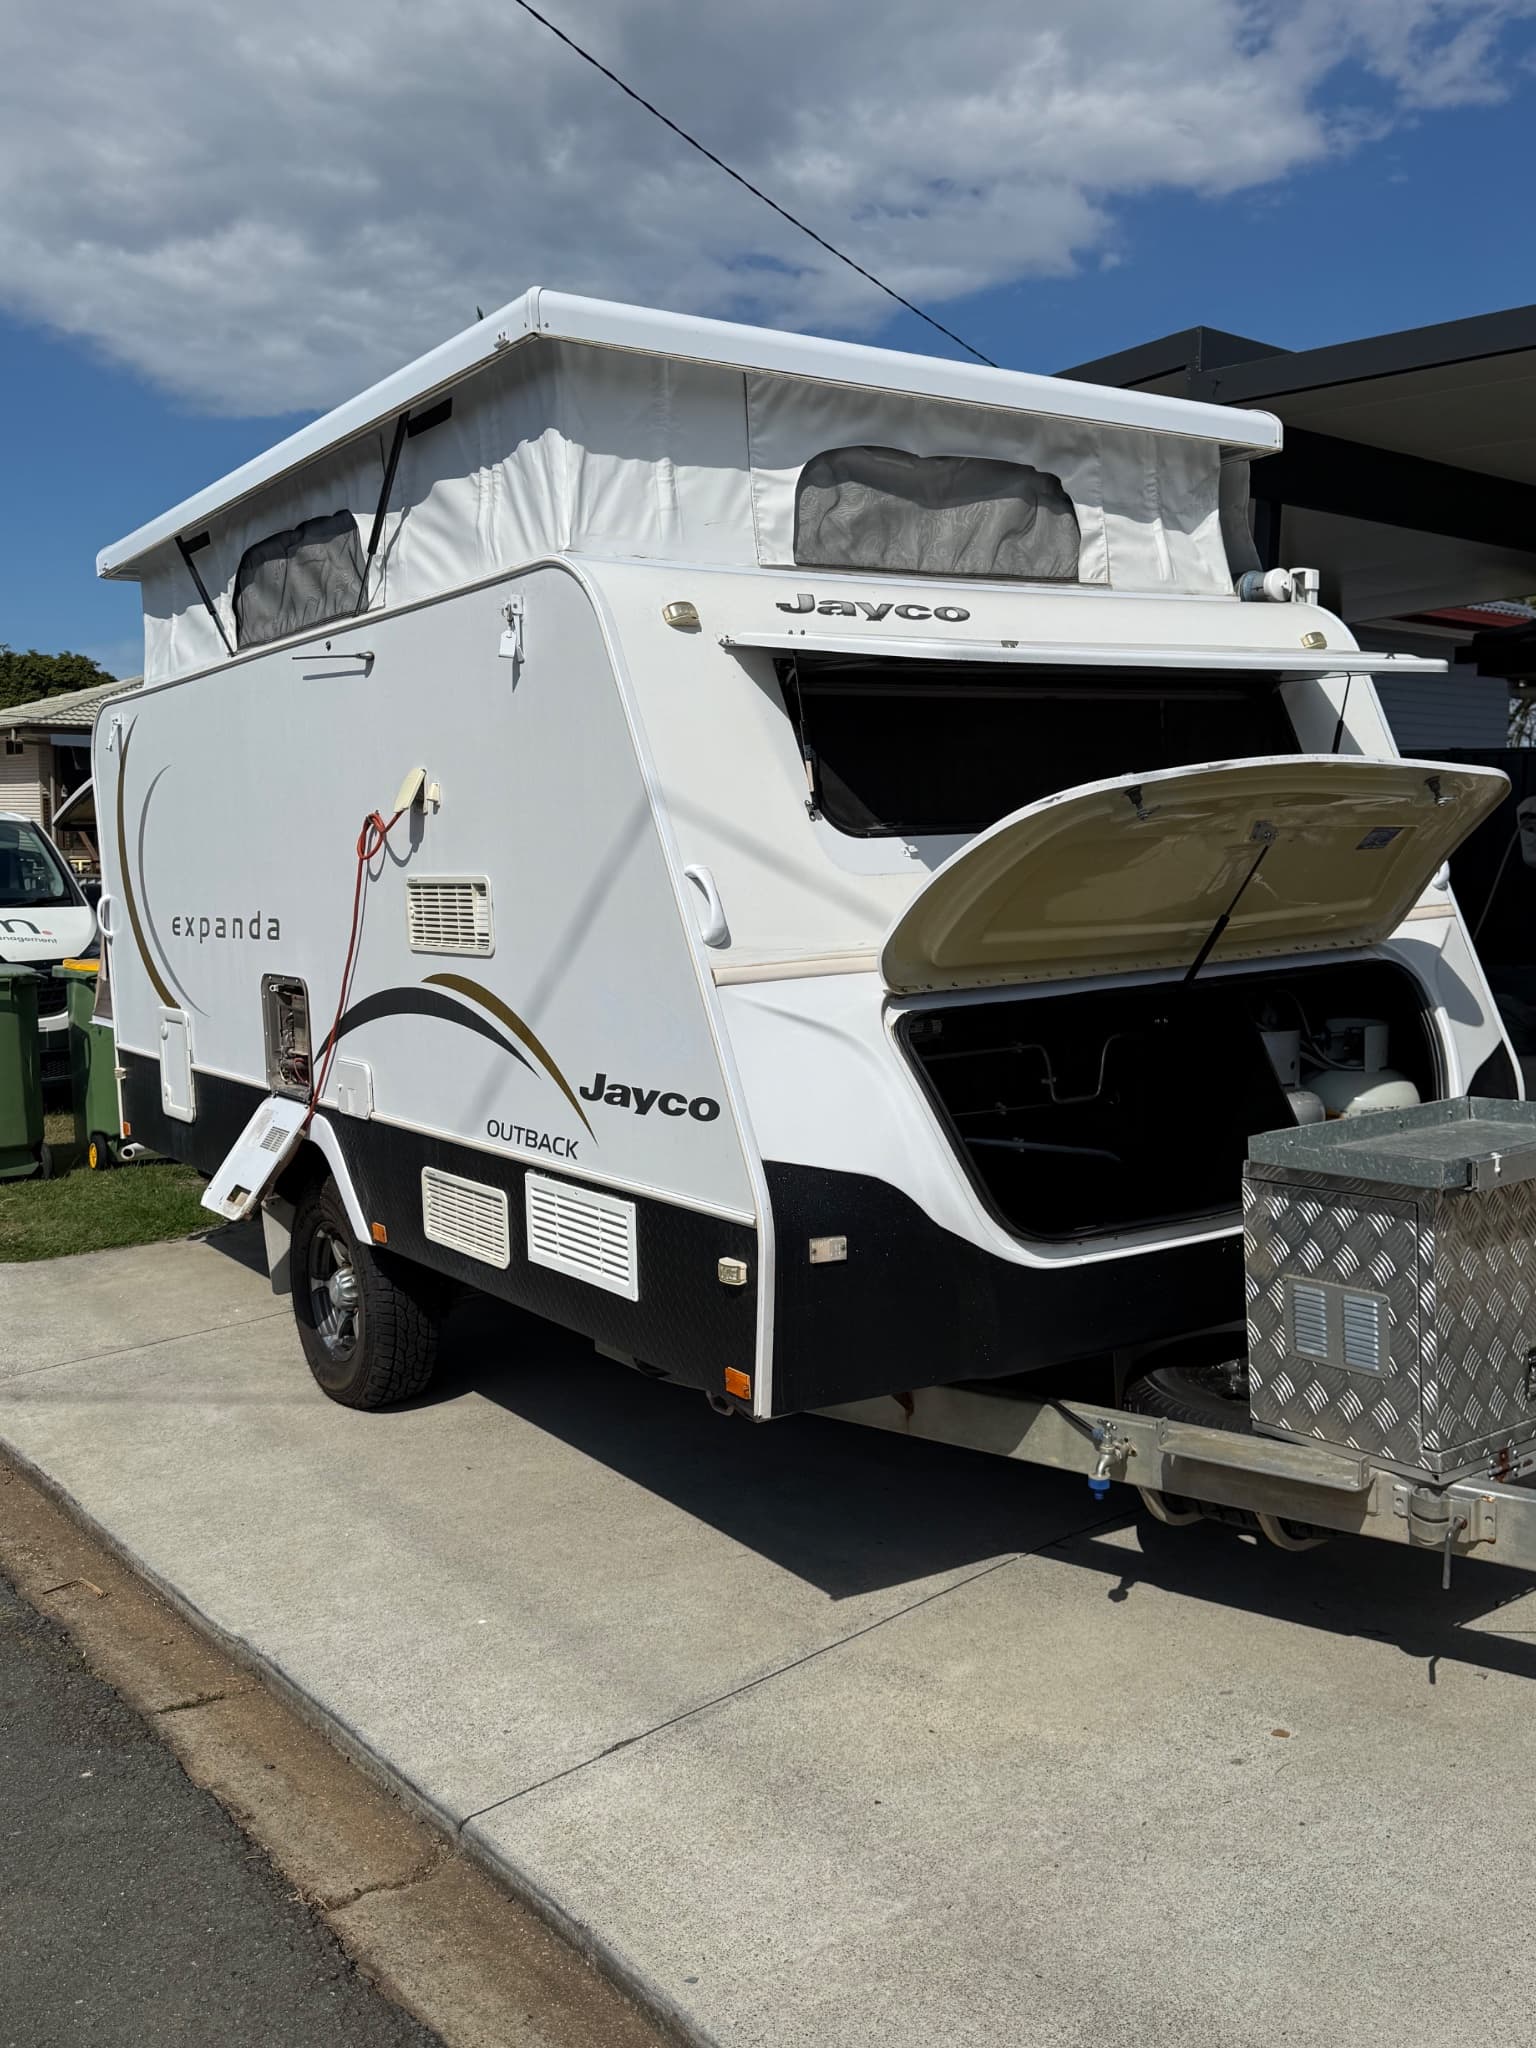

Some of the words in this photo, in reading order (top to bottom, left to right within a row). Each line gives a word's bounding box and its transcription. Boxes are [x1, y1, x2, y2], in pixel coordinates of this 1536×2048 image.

[776, 593, 970, 622] Jayco
[172, 910, 280, 944] expanda
[579, 1073, 721, 1122] Jayco
[487, 1119, 579, 1160] OUTBACK
